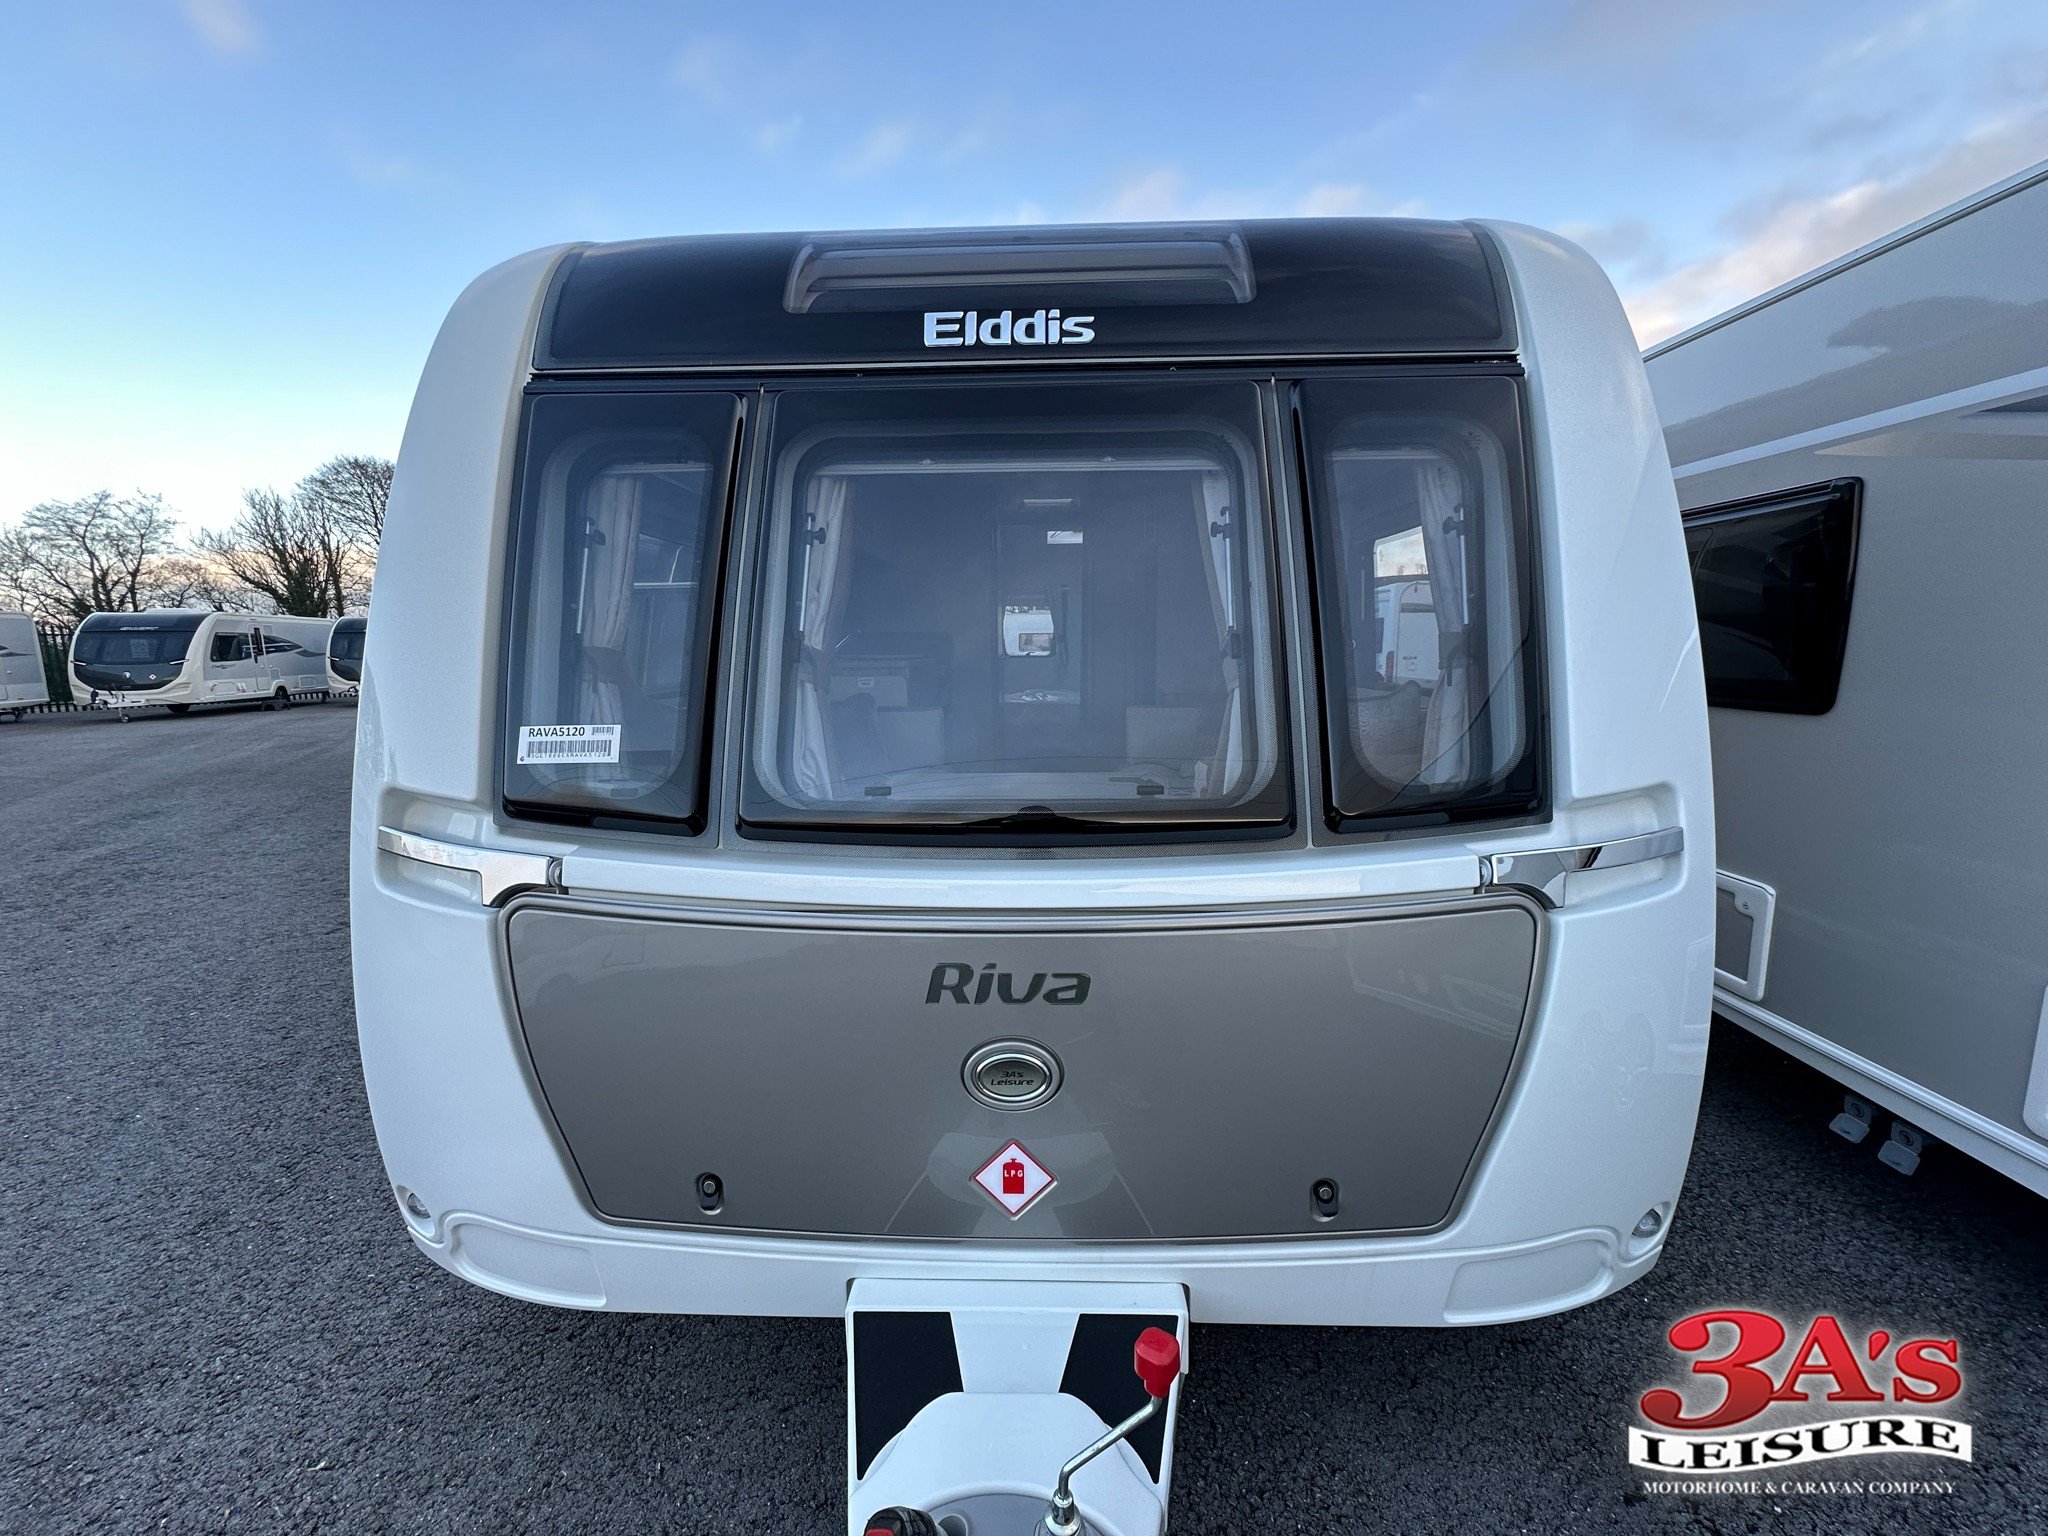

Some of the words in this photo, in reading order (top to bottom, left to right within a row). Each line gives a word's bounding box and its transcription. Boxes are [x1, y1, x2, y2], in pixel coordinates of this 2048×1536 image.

[924, 309, 1095, 347] Elddis
[528, 726, 585, 737] RAVA5120
[925, 962, 1091, 1005] Riva
